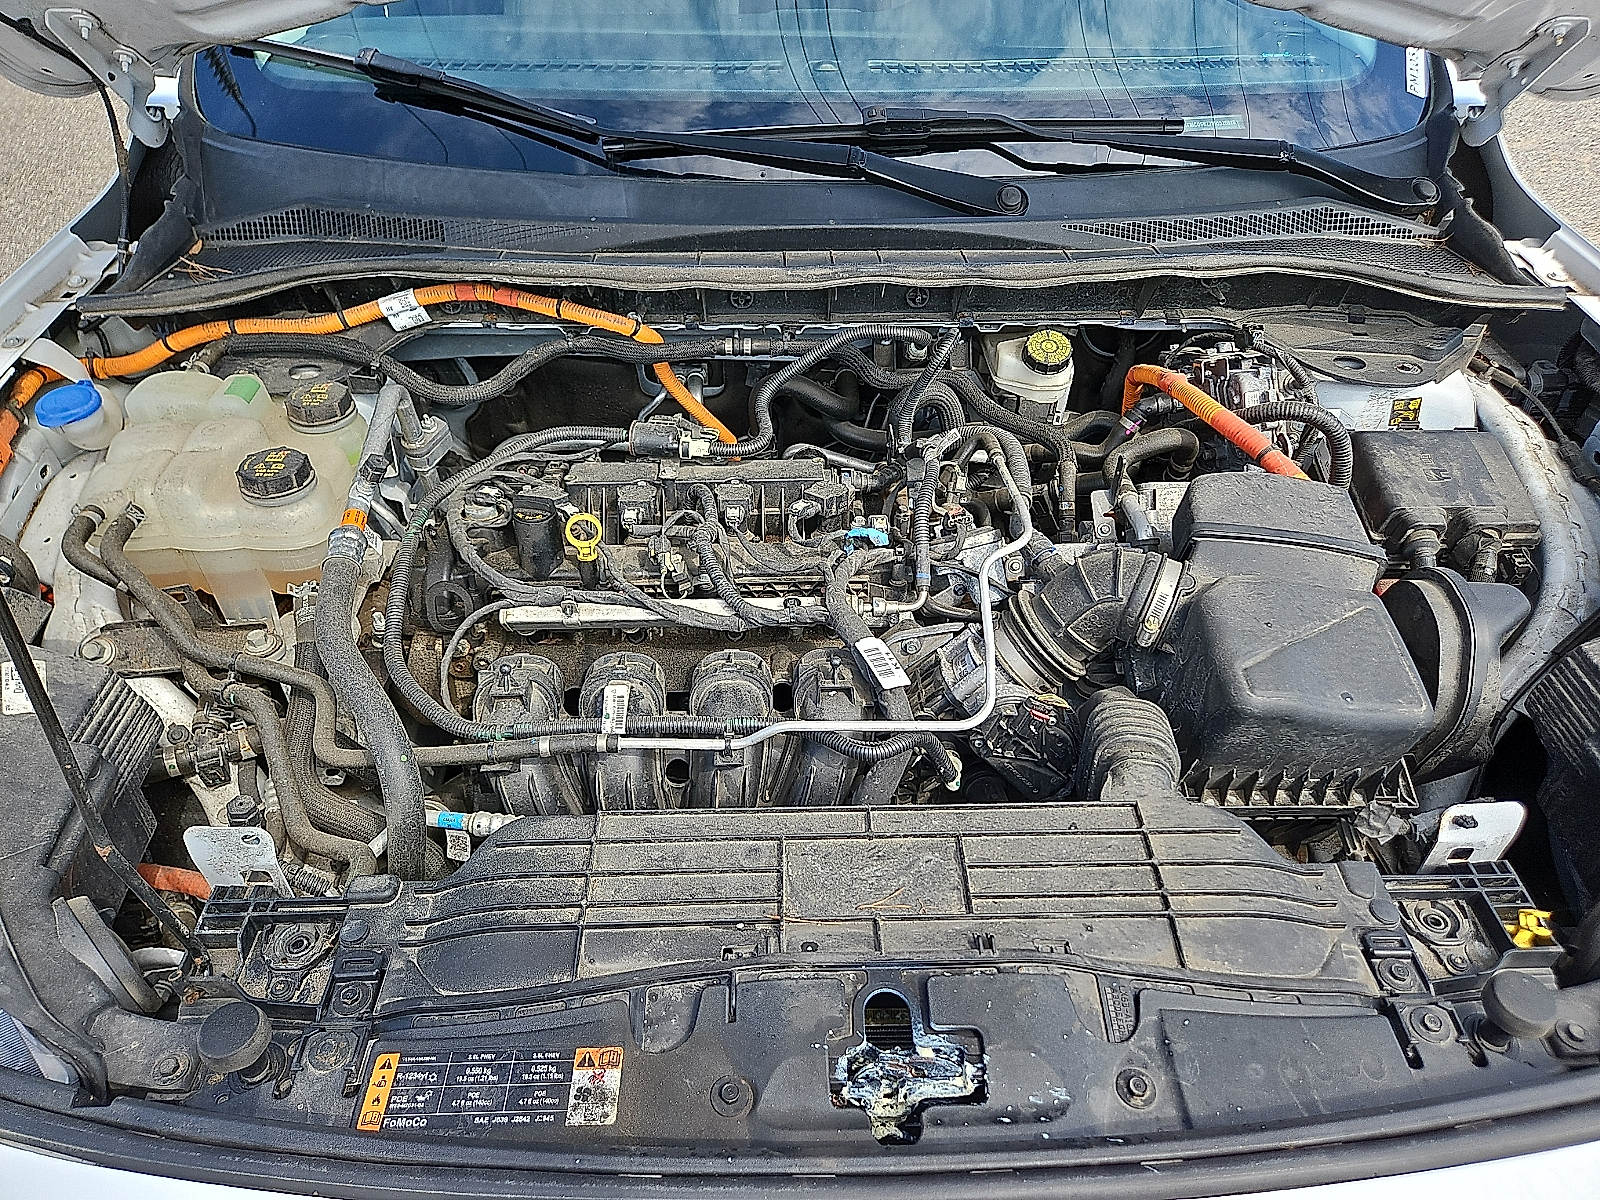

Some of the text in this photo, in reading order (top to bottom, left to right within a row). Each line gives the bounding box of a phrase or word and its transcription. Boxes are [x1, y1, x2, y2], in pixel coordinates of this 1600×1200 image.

[483, 1067, 492, 1076] kg
[549, 1064, 557, 1073] kg
[390, 1095, 408, 1103] POE
[382, 1116, 427, 1128] FoMoCo
